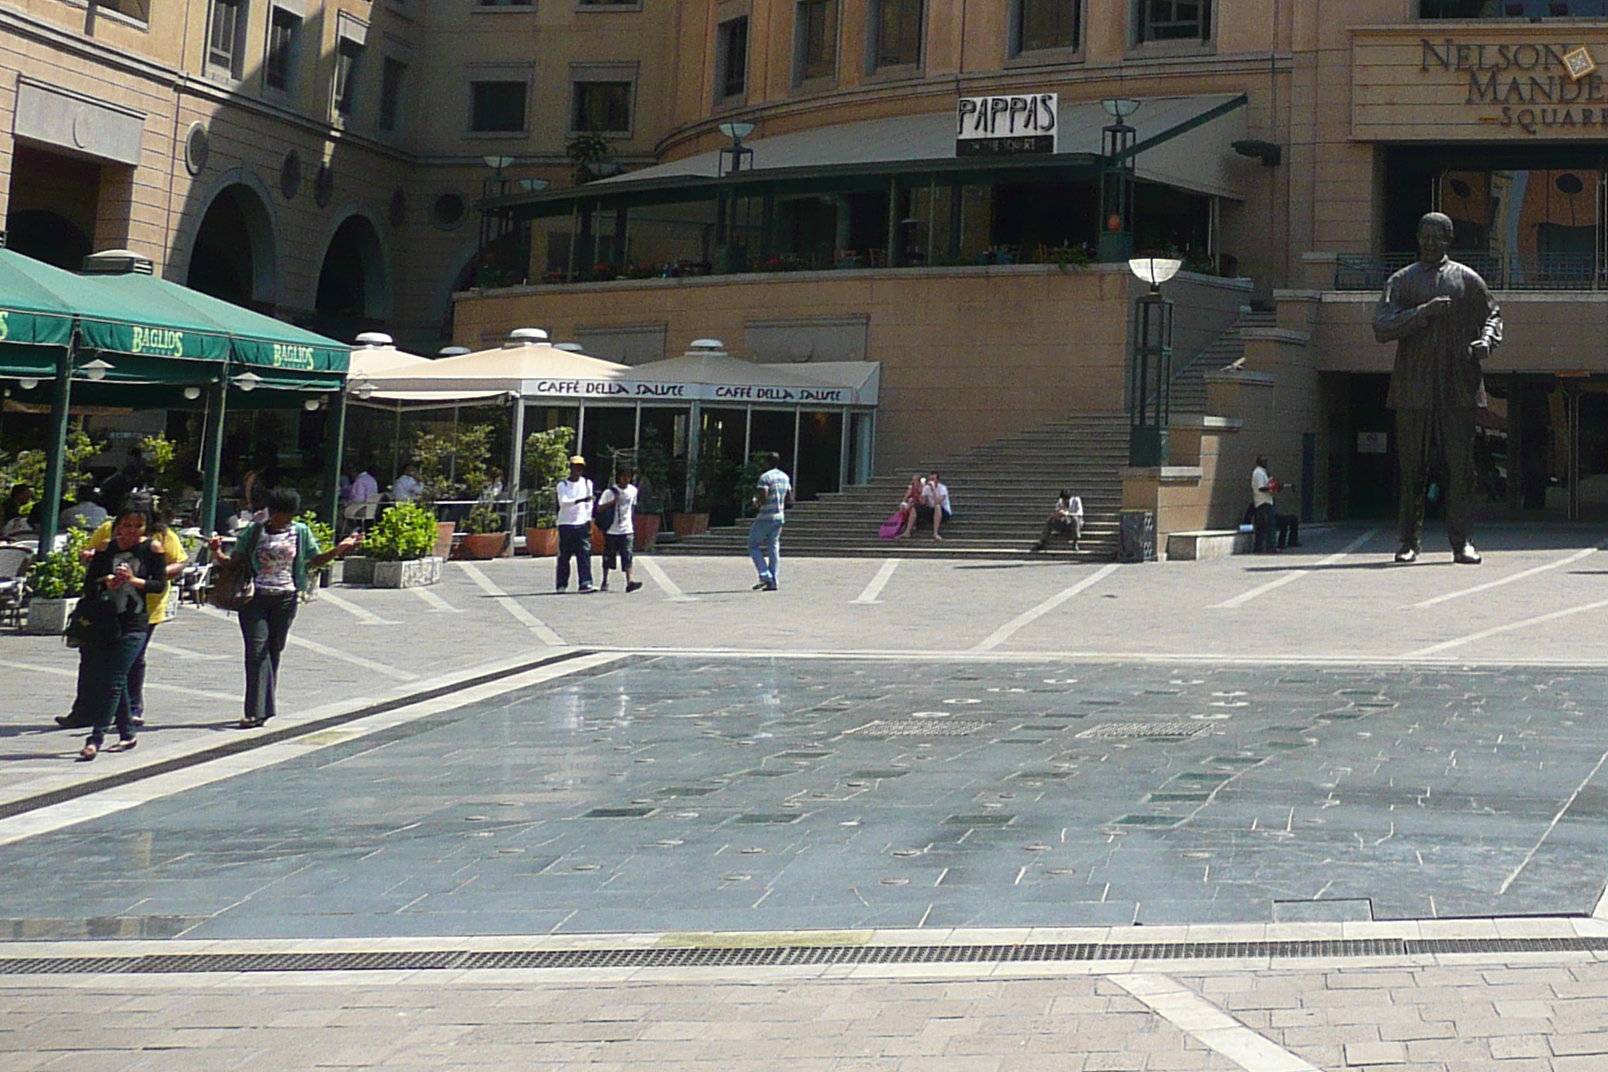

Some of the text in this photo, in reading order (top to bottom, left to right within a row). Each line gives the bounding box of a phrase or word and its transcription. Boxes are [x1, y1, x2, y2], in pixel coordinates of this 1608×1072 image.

[1419, 38, 1569, 71] NELSON
[958, 94, 1055, 134] PAPPAS
[132, 326, 183, 358] BAGLIOS
[273, 344, 314, 370] BAGLIOS
[586, 381, 629, 395] DELLA
[635, 383, 685, 396] SALUTE
[756, 388, 794, 399] DELLA
[799, 389, 841, 401] SALUTE
